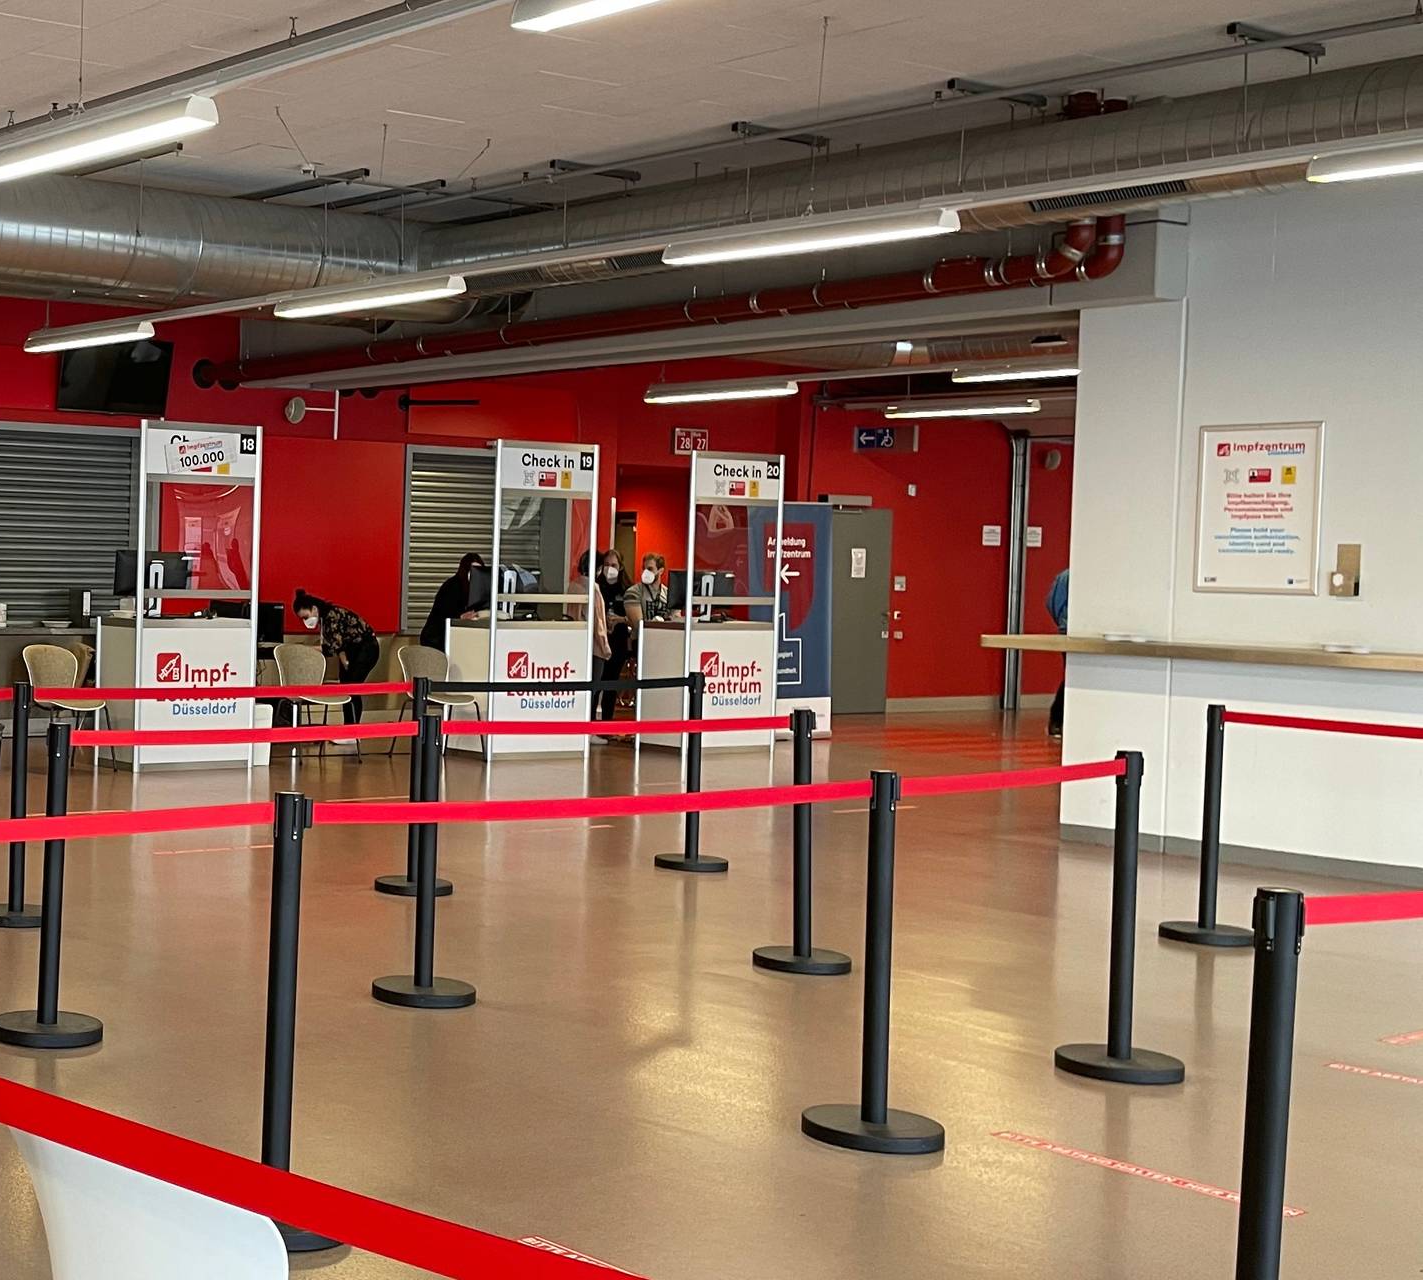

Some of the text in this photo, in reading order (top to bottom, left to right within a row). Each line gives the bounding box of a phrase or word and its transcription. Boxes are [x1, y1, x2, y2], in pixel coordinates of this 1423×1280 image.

[241, 438, 255, 451] 18
[680, 437, 706, 450] 28 27
[1233, 441, 1306, 455] Impfzentrum
[179, 450, 225, 468] 100.000
[522, 453, 593, 469] Check in 19
[713, 463, 779, 478] Check in 20
[185, 663, 237, 686] Impf-
[531, 661, 575, 682] Impf-
[721, 661, 762, 681] Impf-
[703, 680, 761, 694] entrum
[520, 697, 575, 709] Düsseldorf
[711, 695, 761, 706] Düsseldorf
[172, 702, 237, 715] Düsseldorf
